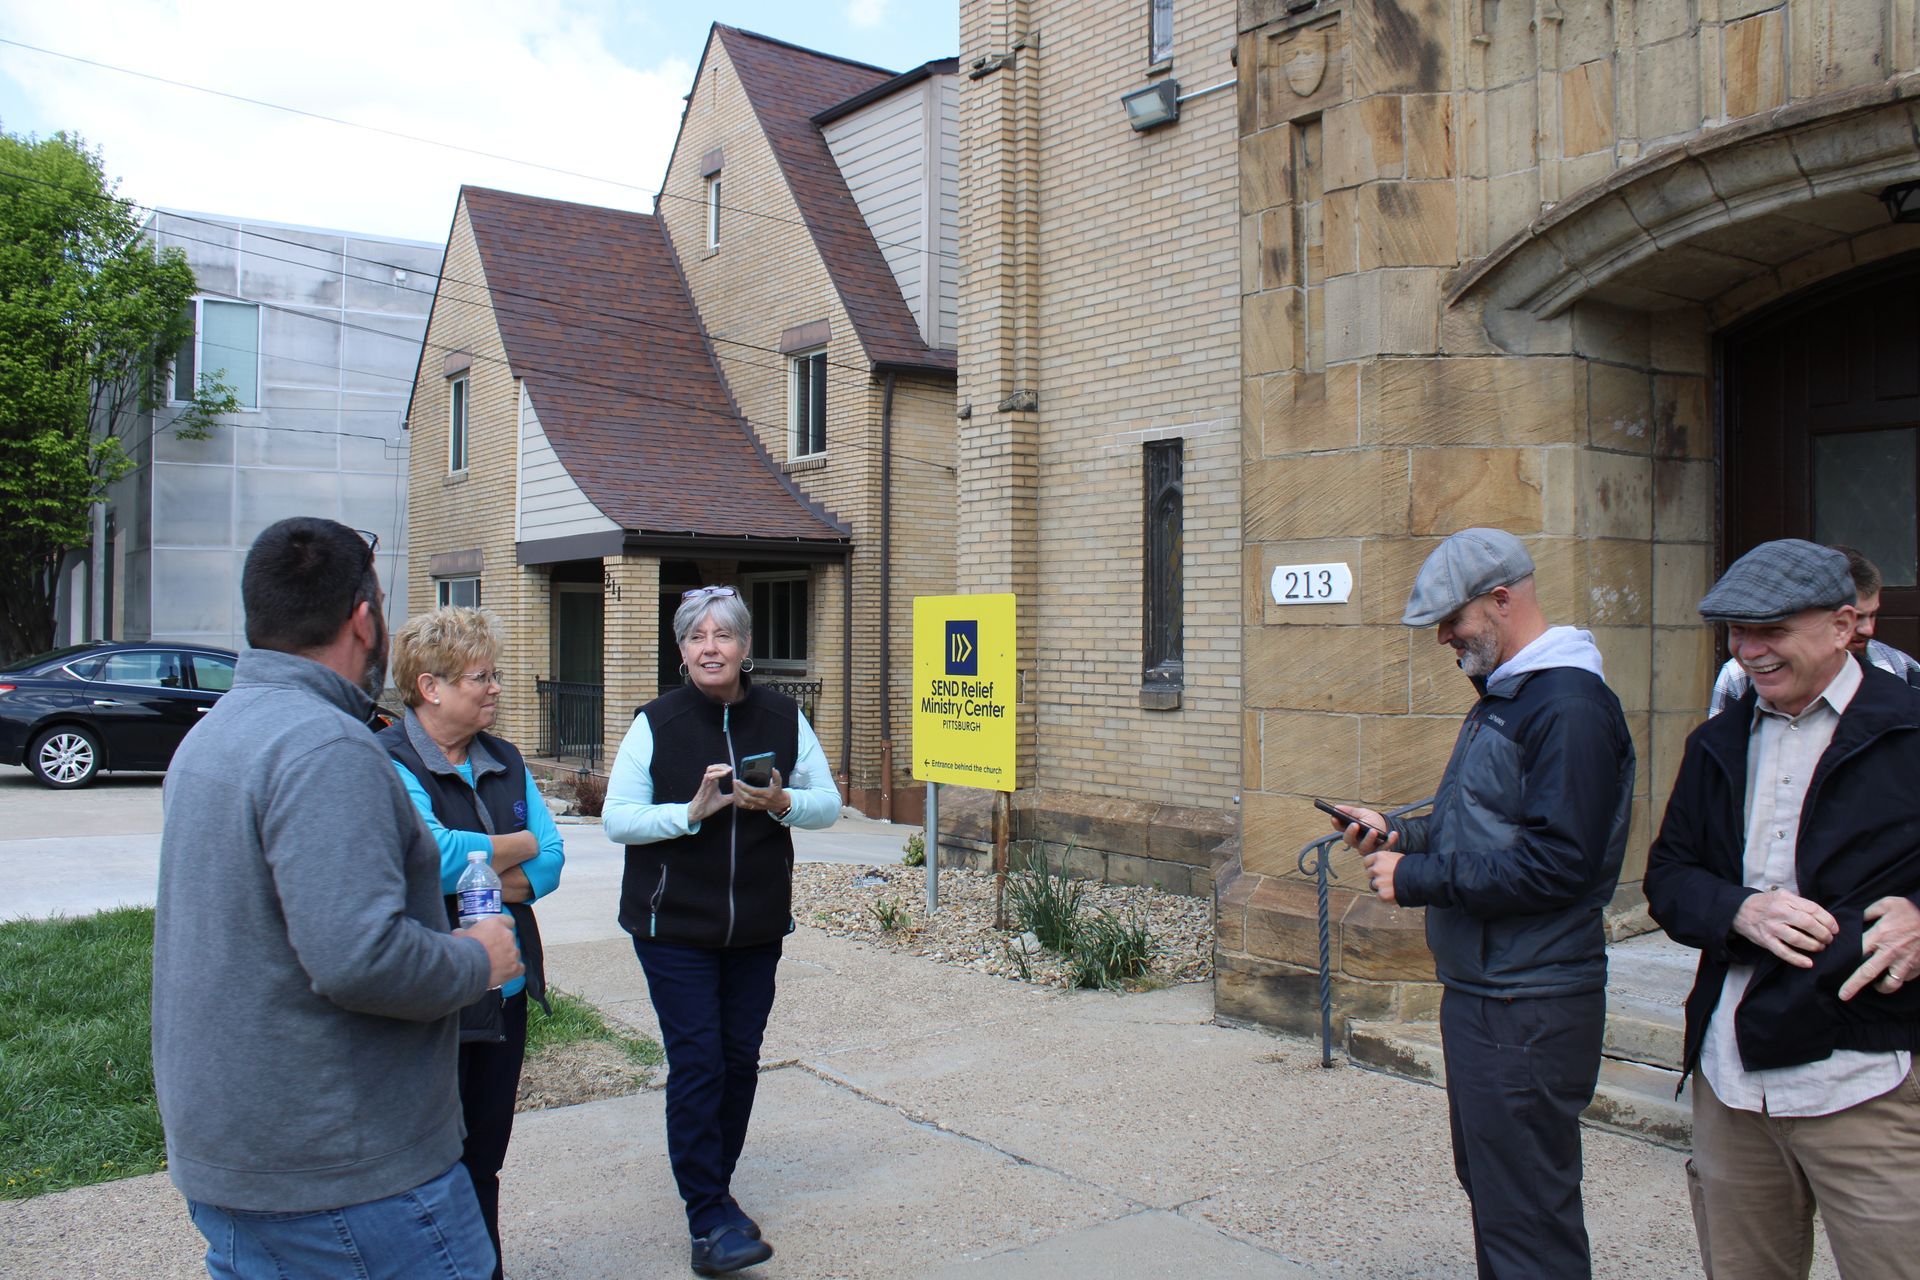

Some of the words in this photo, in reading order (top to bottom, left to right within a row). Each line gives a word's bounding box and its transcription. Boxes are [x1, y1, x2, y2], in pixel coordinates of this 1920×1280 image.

[605, 572, 622, 602] 211
[1285, 570, 1332, 599] 213
[931, 680, 959, 696] SEND
[962, 681, 993, 698] Relief
[921, 697, 962, 719] Ministry
[965, 699, 1005, 718] Center
[942, 719, 981, 732] PITTSBURGH
[931, 759, 954, 769] Entrance
[954, 762, 973, 772] behind
[973, 764, 983, 773] the
[983, 765, 1003, 775] church
